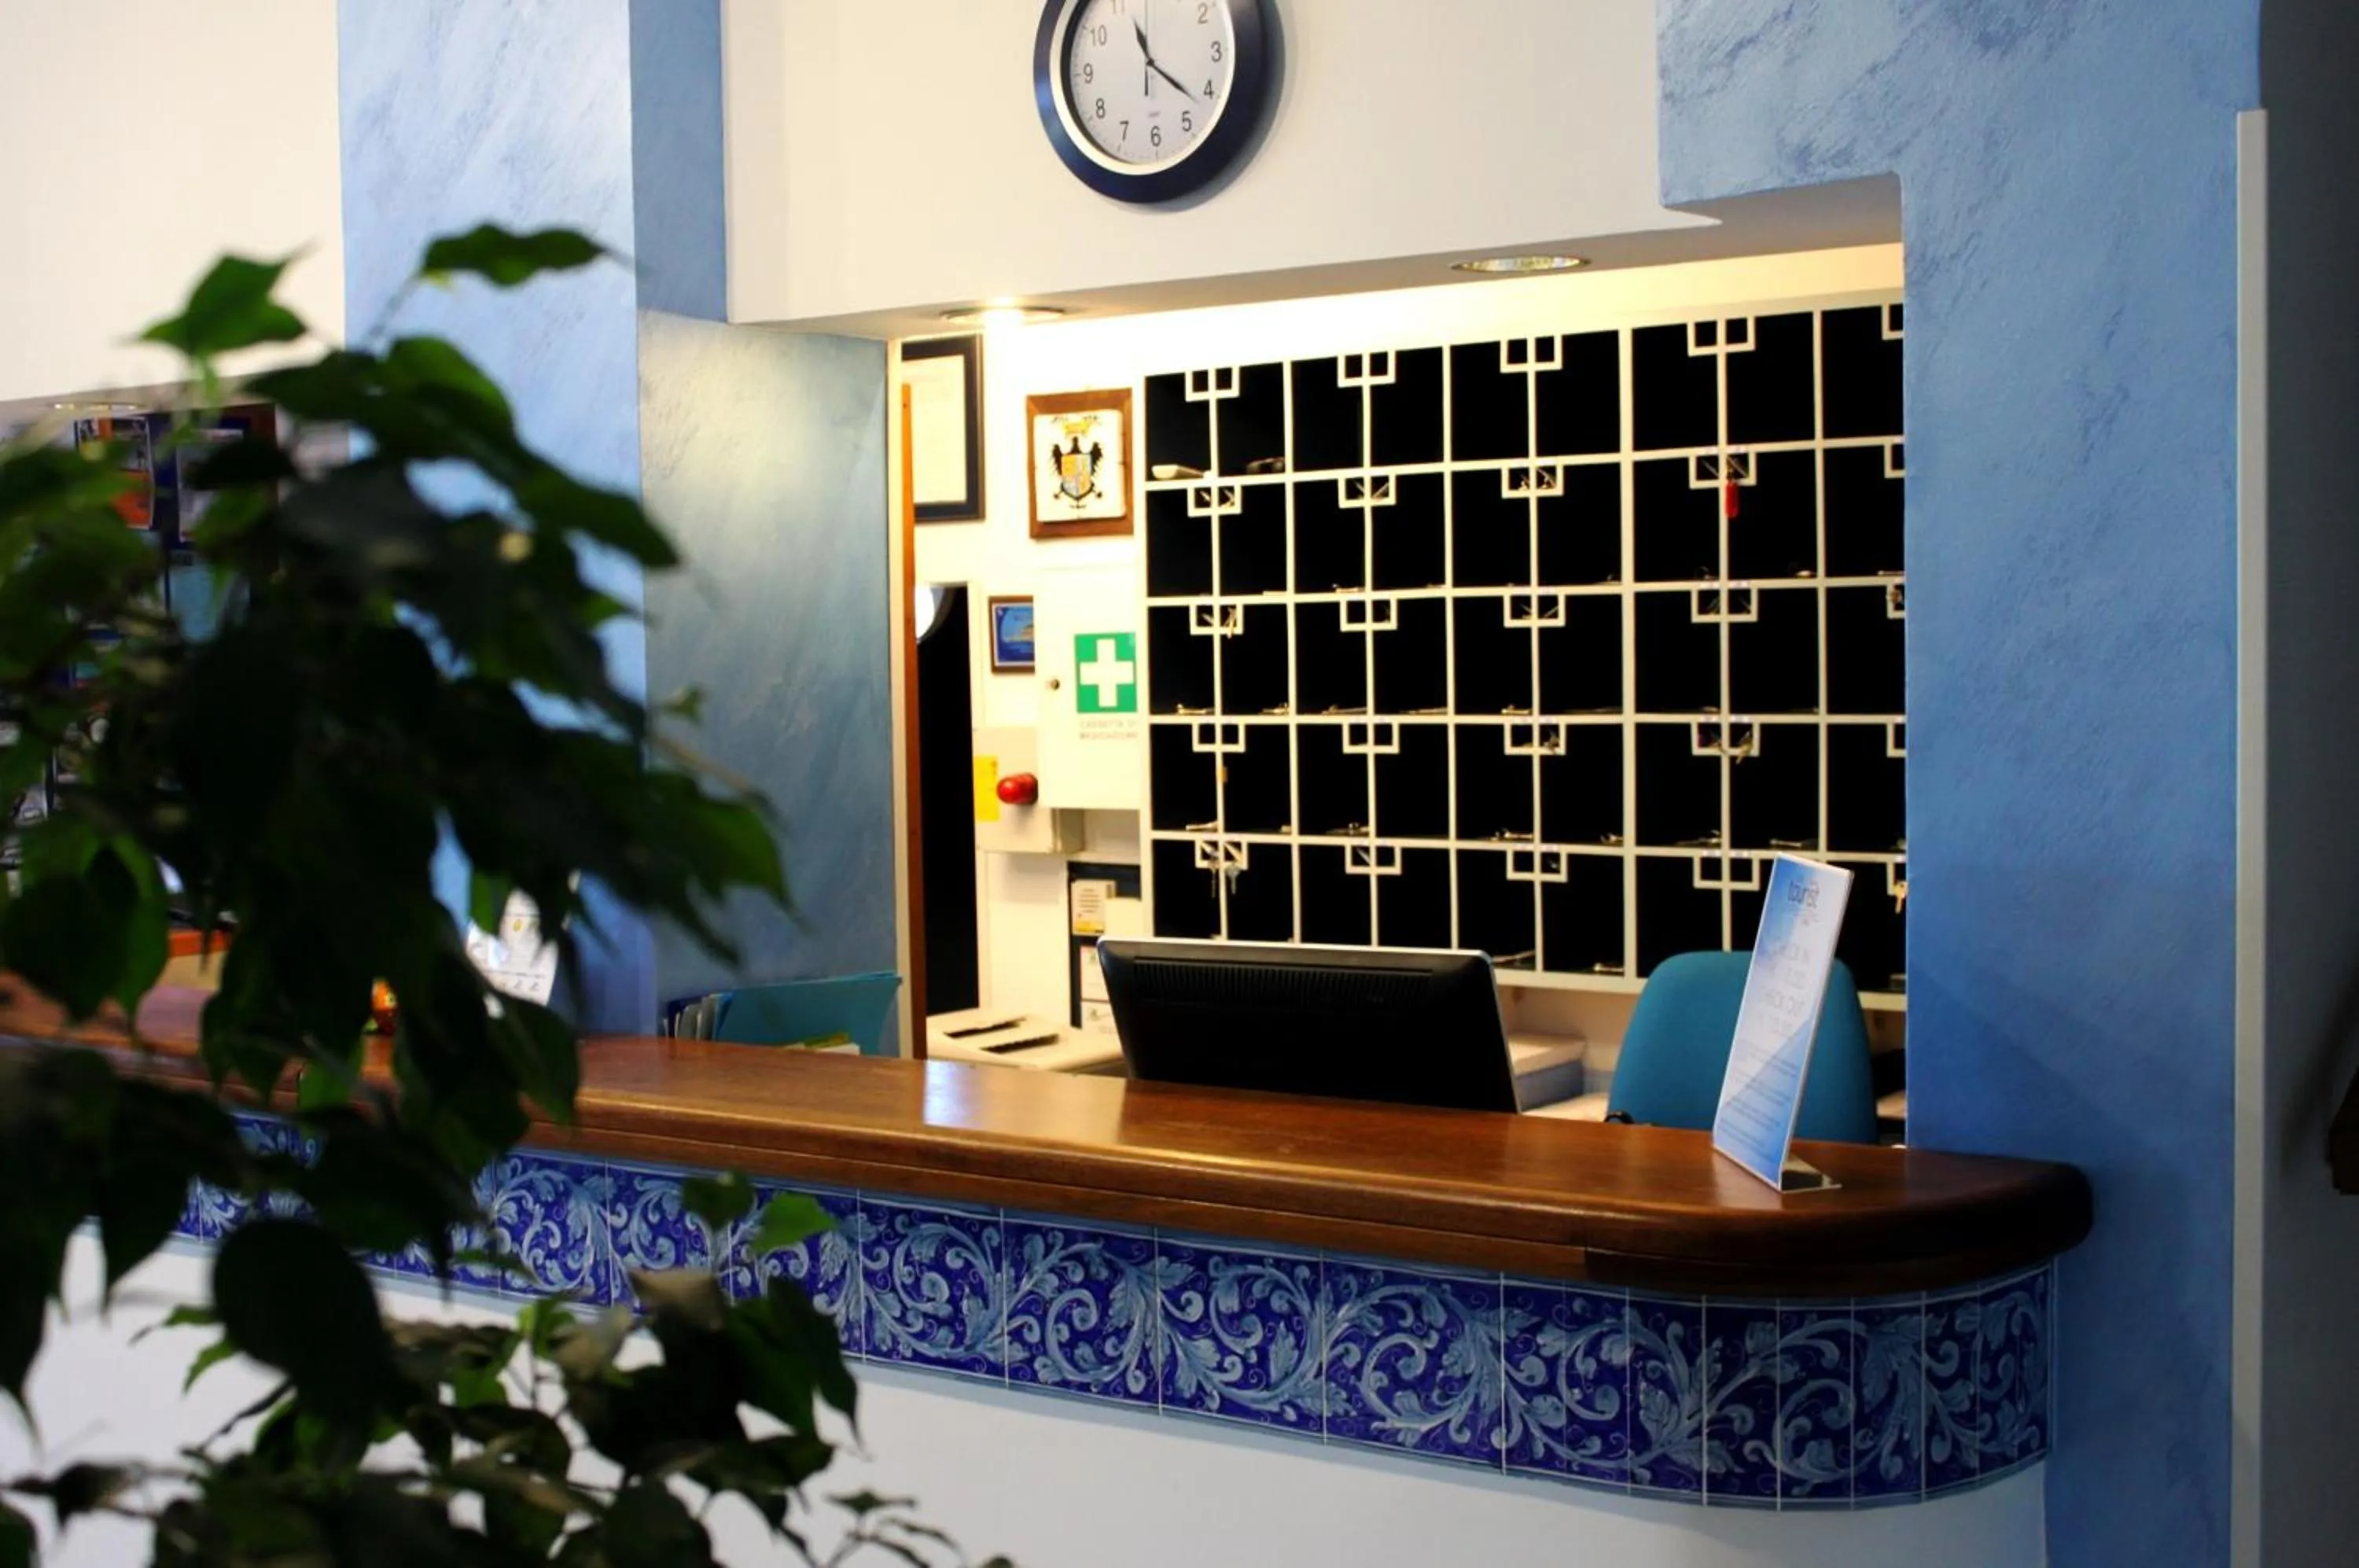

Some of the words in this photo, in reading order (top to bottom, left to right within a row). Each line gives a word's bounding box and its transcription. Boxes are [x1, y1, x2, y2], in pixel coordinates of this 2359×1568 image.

[1197, 2, 1209, 24] 2
[1091, 24, 1107, 46] 10
[1210, 41, 1223, 63] 3
[1083, 63, 1094, 84] 9
[1203, 79, 1214, 100] 4
[1095, 98, 1106, 120] 8
[1120, 120, 1129, 142] 7
[1181, 111, 1192, 132] 5
[1150, 125, 1161, 147] 6
